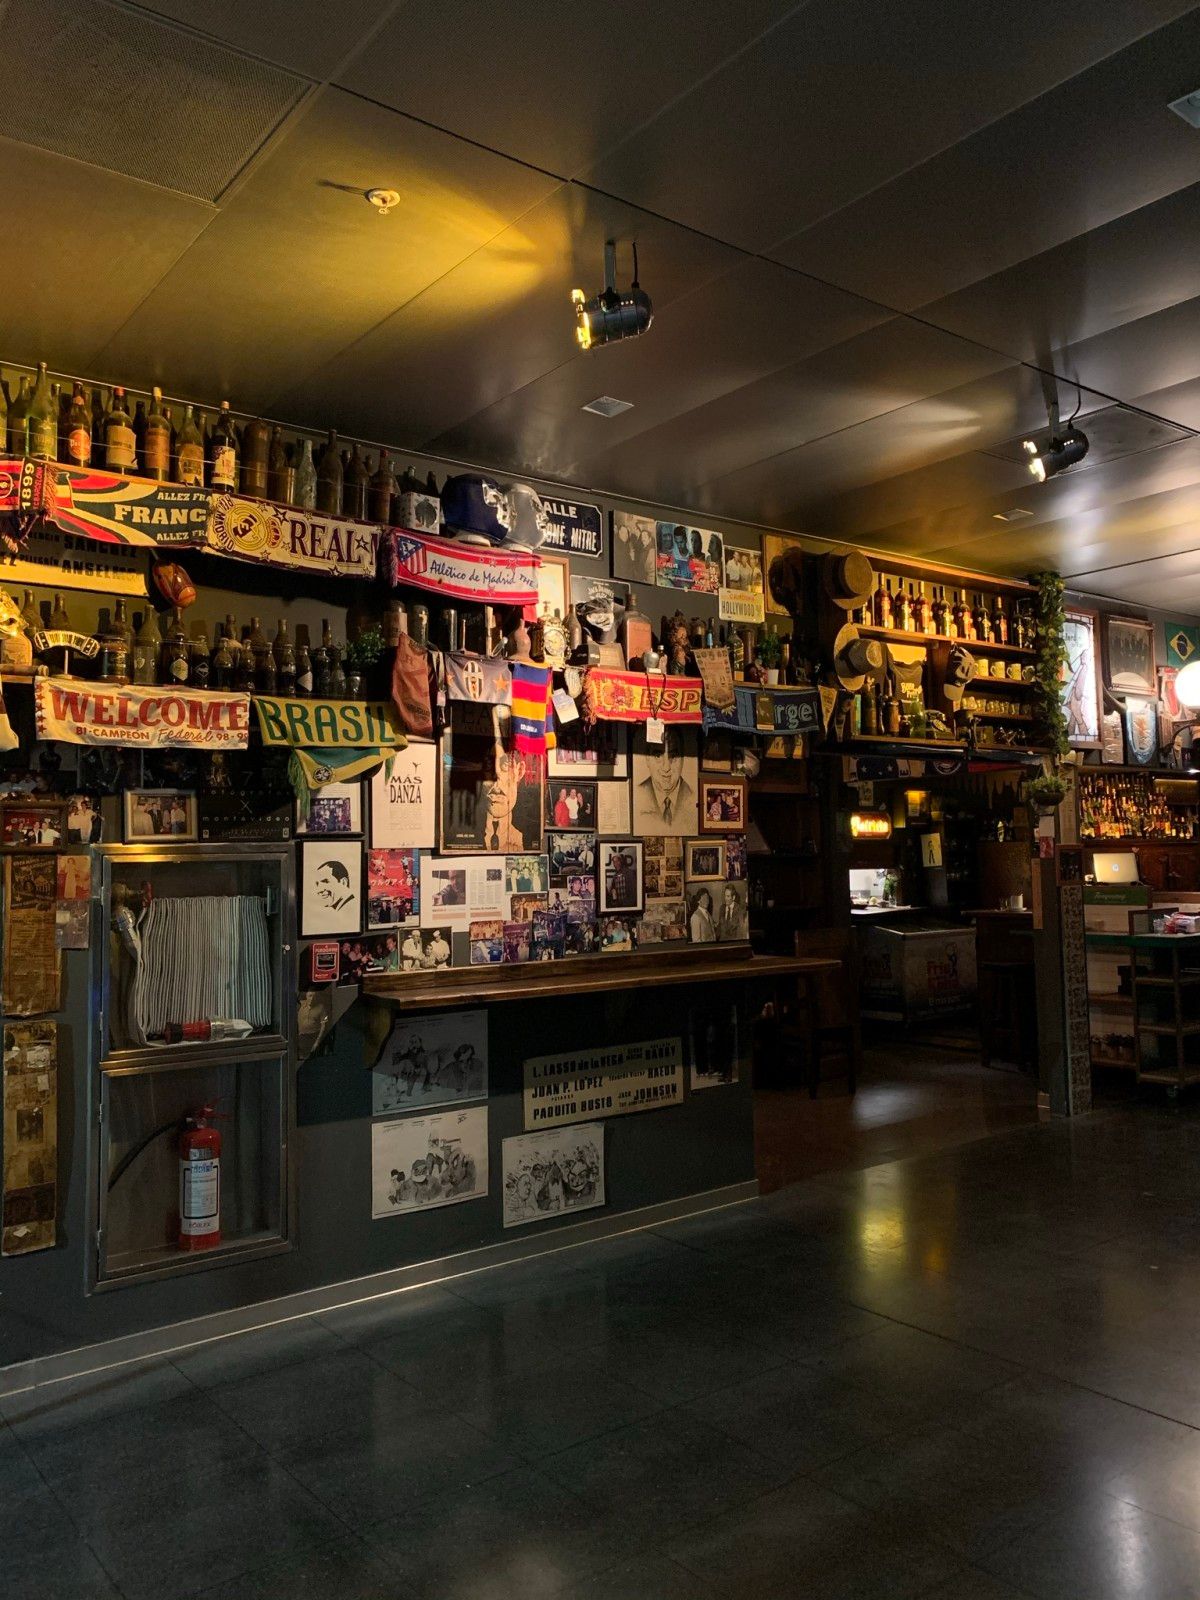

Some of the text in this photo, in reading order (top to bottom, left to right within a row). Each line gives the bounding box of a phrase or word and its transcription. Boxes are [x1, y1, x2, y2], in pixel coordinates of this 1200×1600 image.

[21, 462, 35, 511] 1899
[157, 492, 190, 501] ALLEZ
[113, 504, 207, 525] FRANC
[544, 501, 578, 518] ALLE
[156, 532, 190, 541] ALLEZ
[214, 510, 236, 552] MADRID
[570, 527, 597, 552] MITRE
[290, 520, 362, 564] REAL
[468, 569, 481, 582] de
[482, 572, 516, 586] Madrid
[721, 600, 755, 618] HOLLYWOOD
[640, 688, 700, 712] ESP
[49, 688, 248, 731] WELCOME
[258, 700, 397, 743] BRASIL
[157, 728, 213, 743] Federal
[390, 785, 422, 803] DANZA
[544, 1060, 576, 1076] LASSO
[532, 1083, 560, 1099] JUAN
[634, 1082, 677, 1101] JOHNSON
[533, 1102, 577, 1120] PAQUITO
